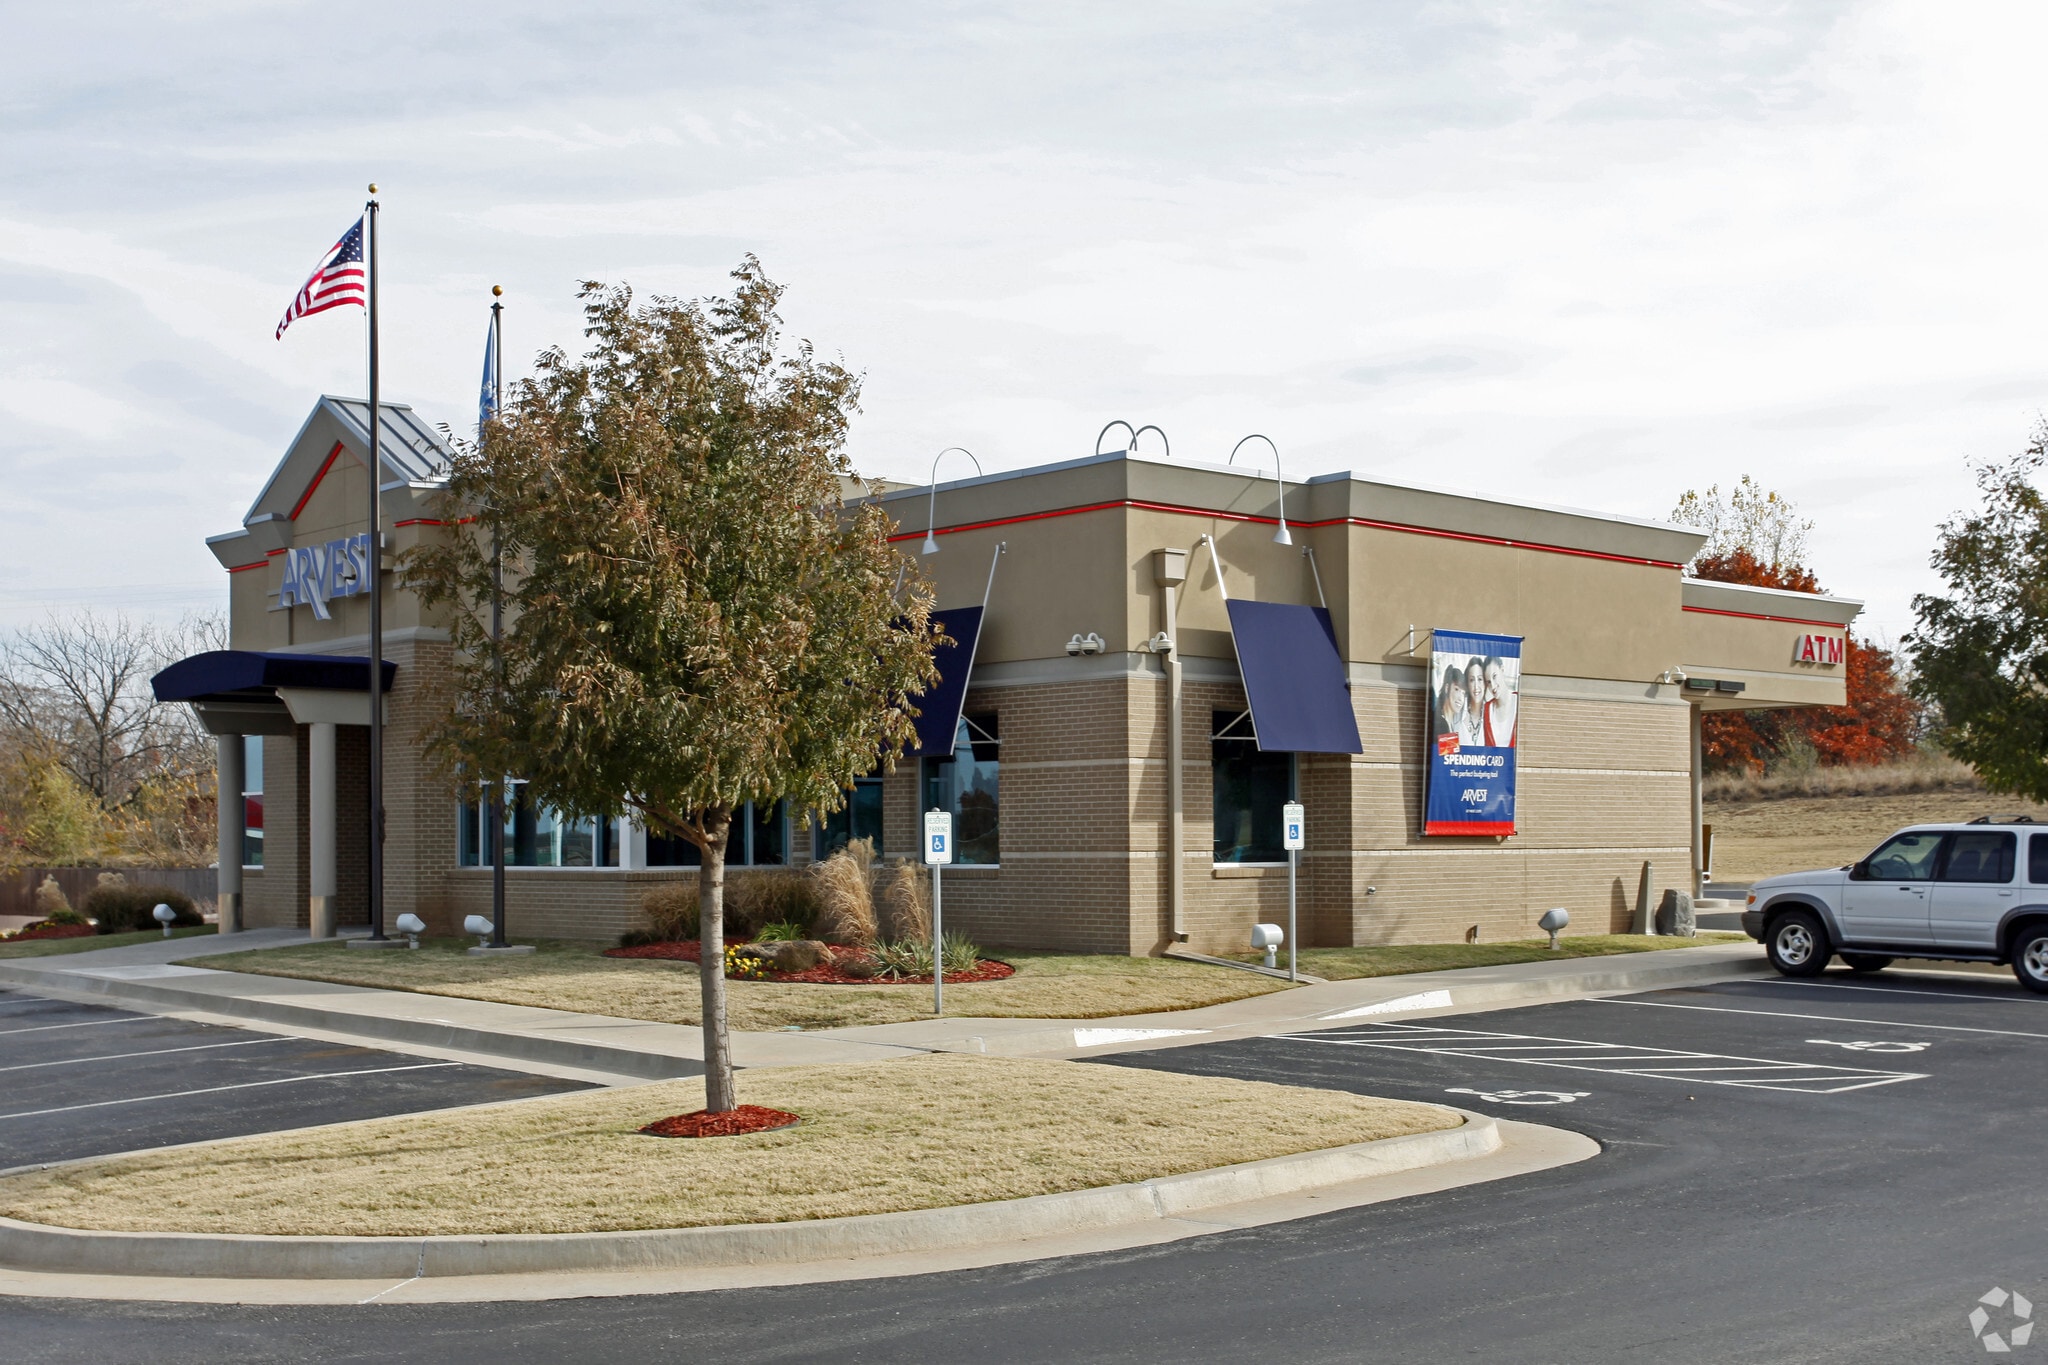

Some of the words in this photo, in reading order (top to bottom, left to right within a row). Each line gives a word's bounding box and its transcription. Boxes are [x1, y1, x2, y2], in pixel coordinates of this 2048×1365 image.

[278, 533, 378, 620] ARVEST
[1799, 634, 1843, 664] ATM
[1443, 754, 1486, 766] SPENDING
[1486, 755, 1504, 767] CARD
[1450, 769, 1458, 777] The
[1458, 769, 1473, 779] perfect
[1473, 770, 1490, 779] budgeting
[1490, 770, 1498, 778] tool
[1460, 789, 1488, 806] ARVEST
